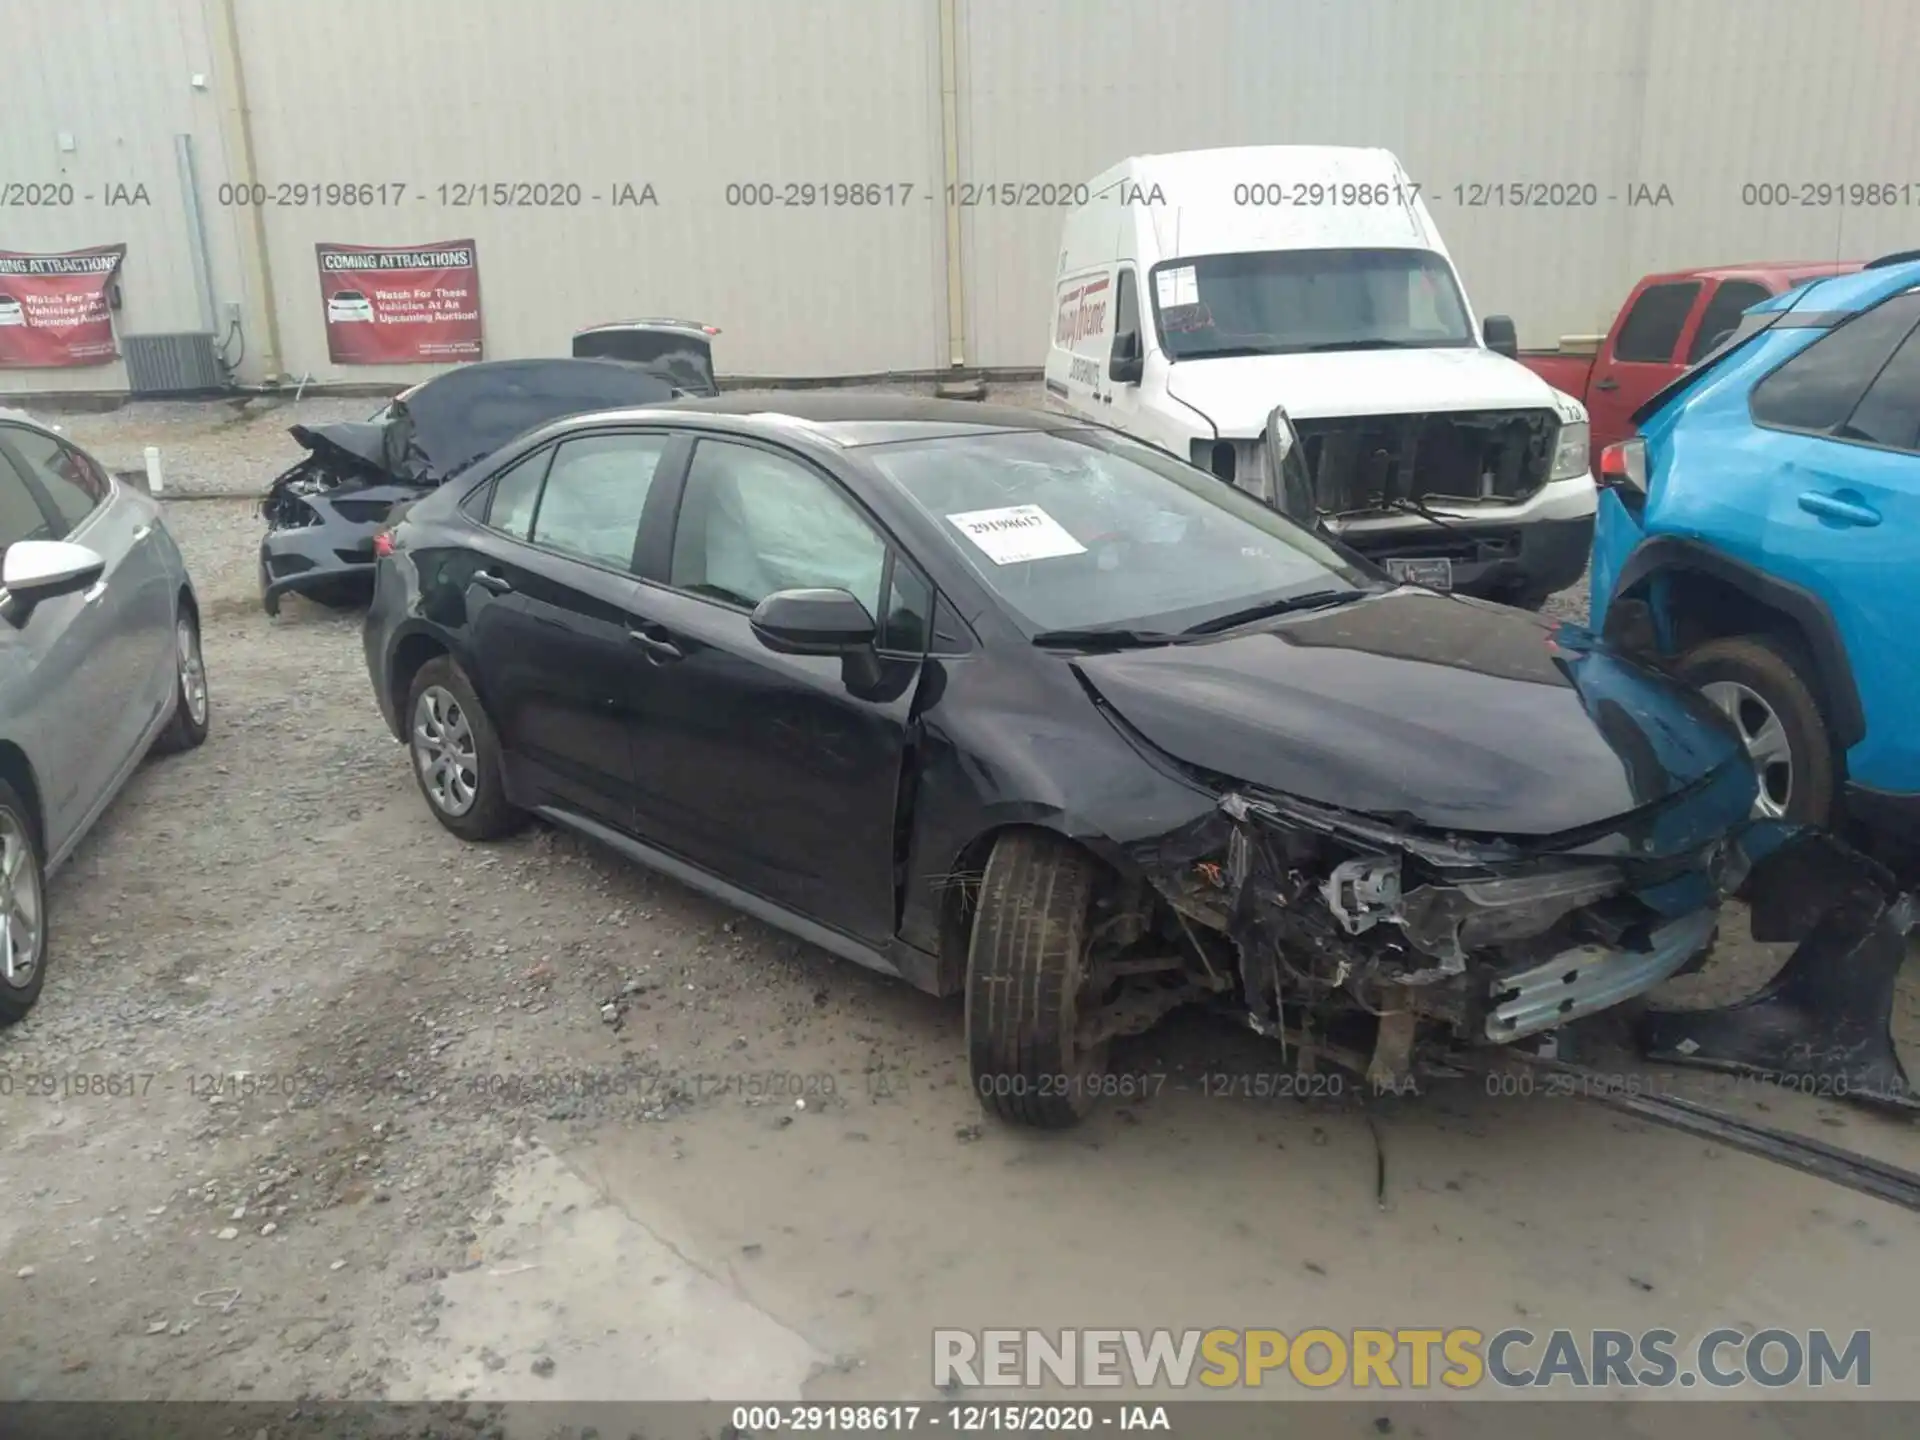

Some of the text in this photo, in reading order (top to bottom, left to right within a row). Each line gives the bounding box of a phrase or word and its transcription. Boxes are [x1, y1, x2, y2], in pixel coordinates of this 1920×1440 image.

[29, 256, 118, 272] ATTRACTIONS
[325, 251, 468, 269] COMING ATTRACTIONS
[375, 287, 468, 300] Watch For These
[377, 299, 459, 312] Vehicles At An
[380, 310, 478, 324] Upcoming Auction!
[967, 516, 1044, 534] 29198617
